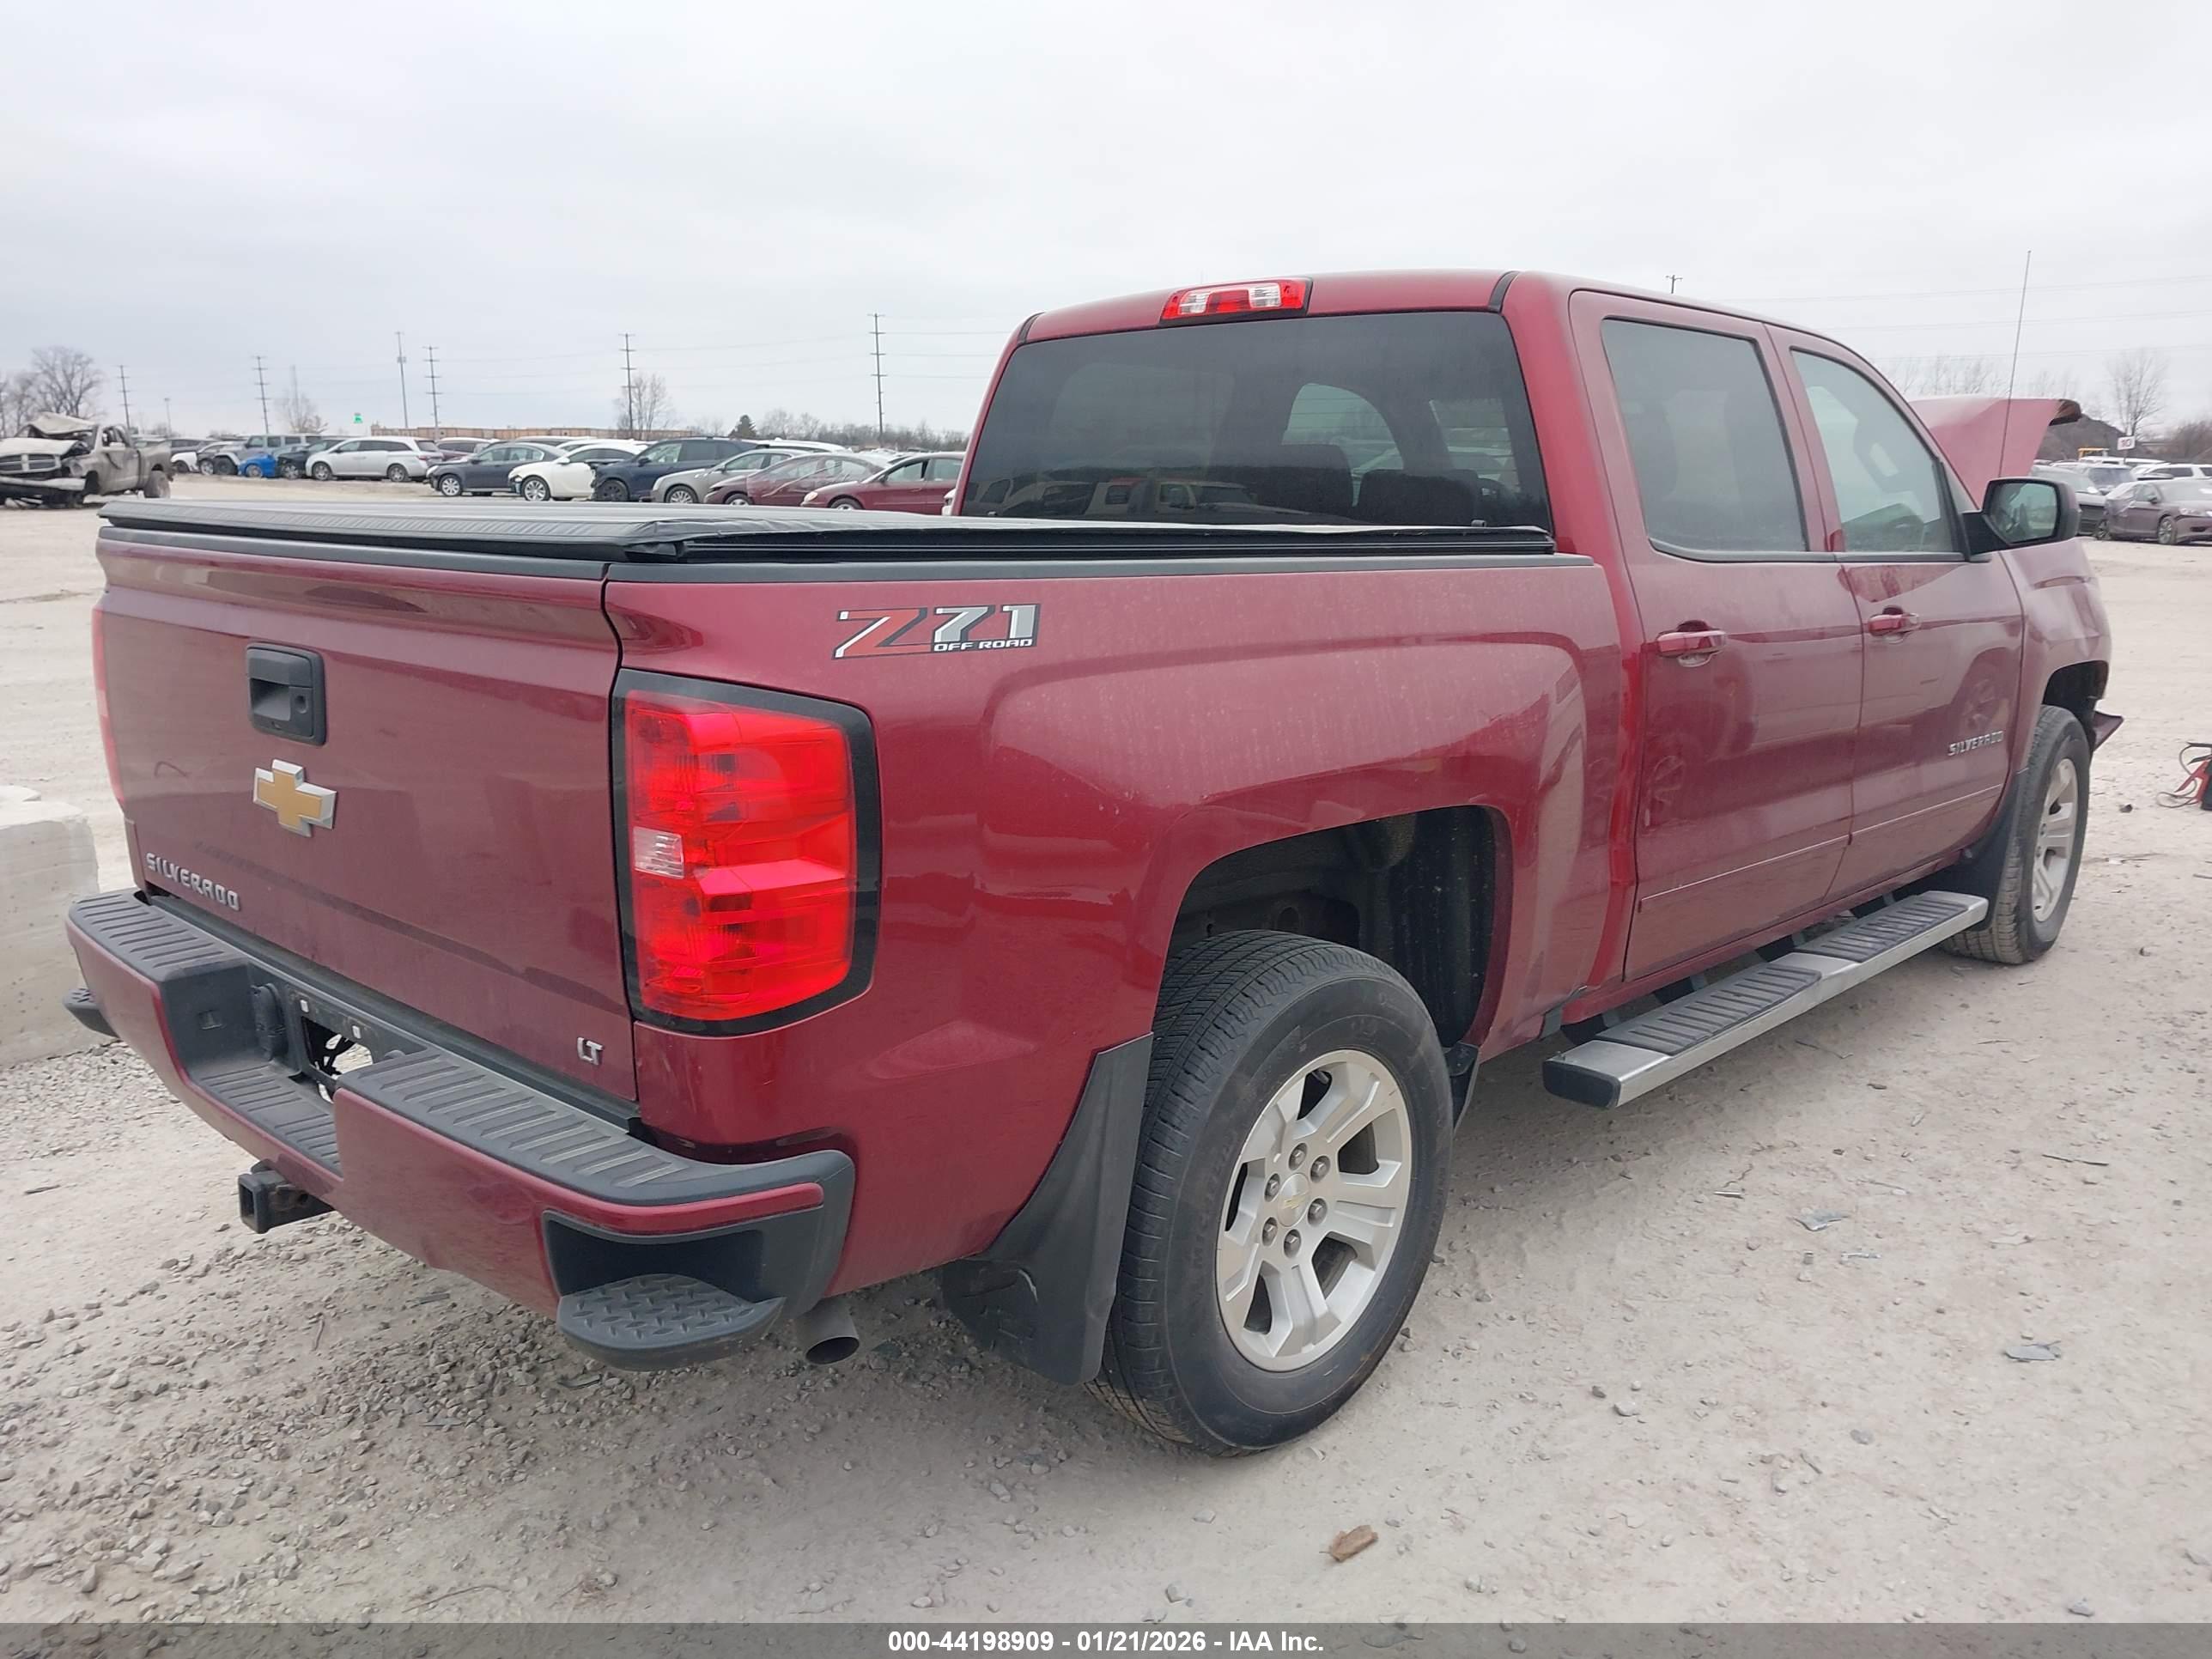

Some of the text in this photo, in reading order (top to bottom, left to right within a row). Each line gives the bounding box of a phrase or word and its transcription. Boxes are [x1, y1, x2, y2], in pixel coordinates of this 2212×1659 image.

[832, 603, 1040, 659] Z71
[933, 639, 1034, 653] OFF ROAD
[146, 852, 240, 911] SILVERADO
[576, 1036, 604, 1066] LT
